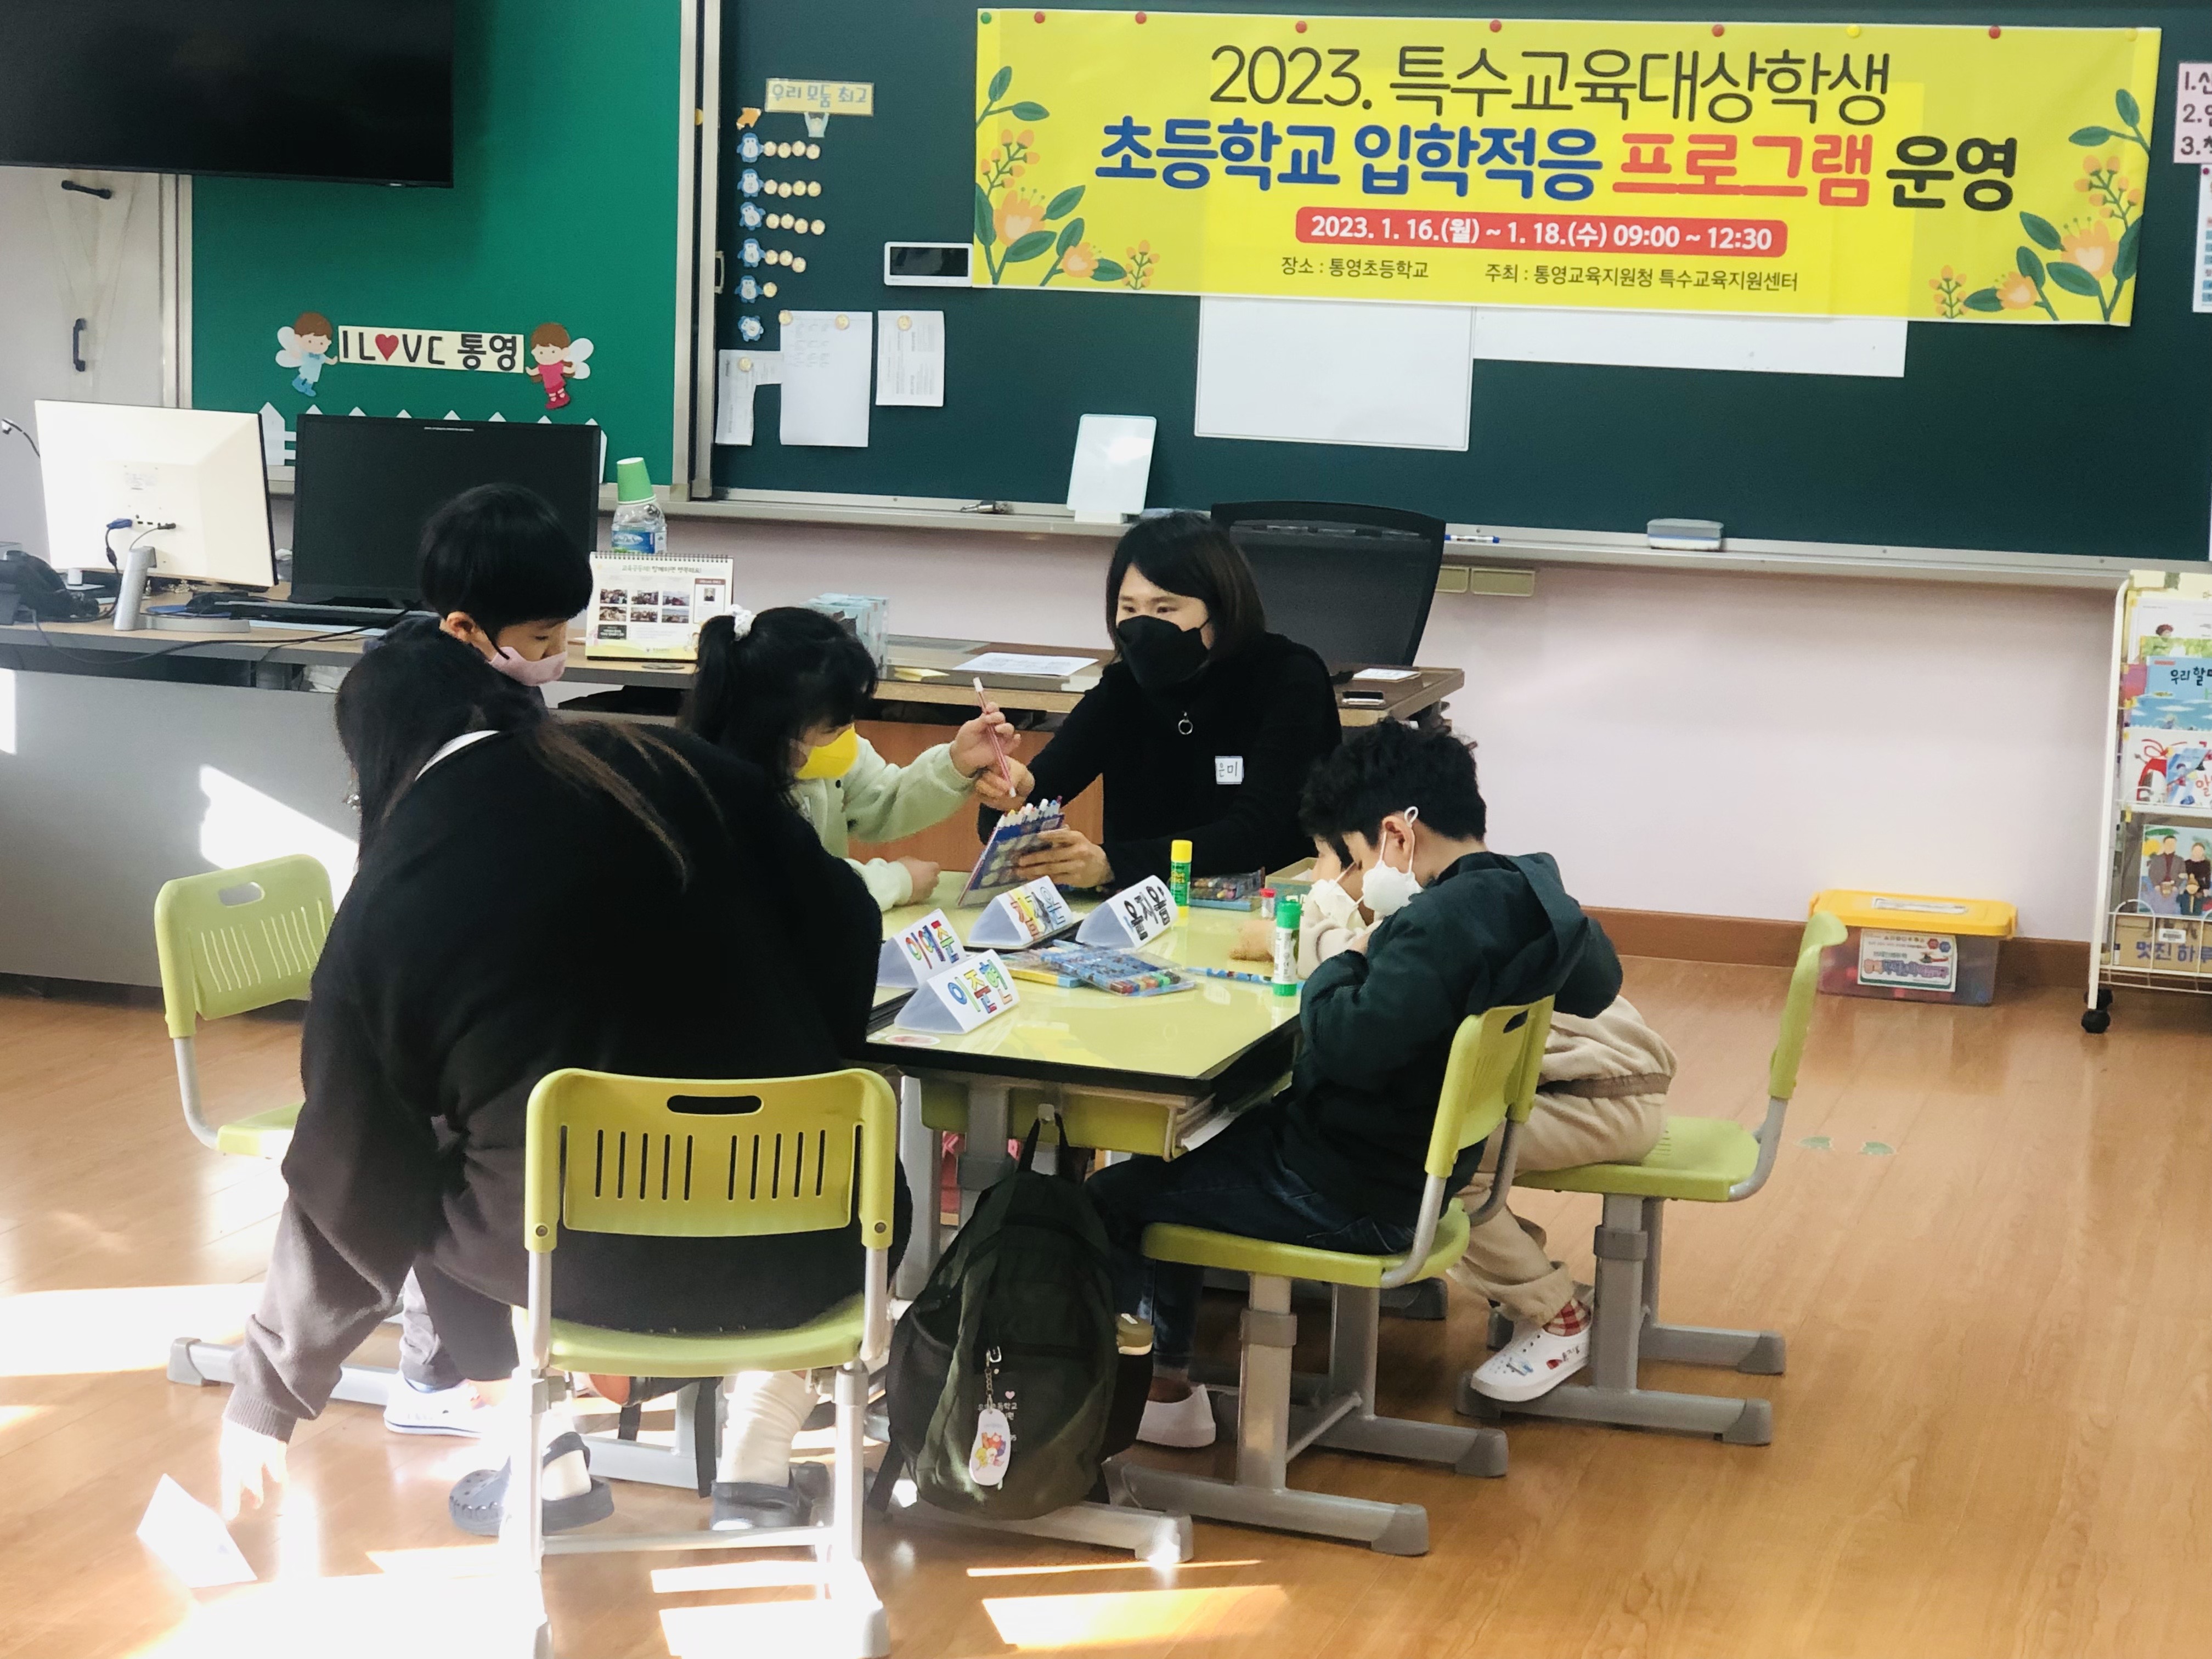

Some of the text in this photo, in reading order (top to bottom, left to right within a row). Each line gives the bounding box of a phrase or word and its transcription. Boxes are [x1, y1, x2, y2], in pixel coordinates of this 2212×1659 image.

[772, 84, 867, 108] 우리 모둠 최고
[1210, 45, 1889, 126] 2023. 특수교육대상학생
[1096, 116, 2018, 211] 초등학교 입학적응 프로그램 운영
[1311, 215, 1374, 239] 2023.
[1383, 218, 1400, 240] 1.
[1508, 221, 1526, 244] 1.
[1613, 224, 1680, 247] 09:00
[1708, 227, 1773, 250] 12:30
[1281, 256, 1314, 275] 장소
[1329, 257, 1429, 280] 통영초등학교
[1485, 263, 1519, 284] 주최
[1533, 264, 1653, 288] 통영교육지원청
[1658, 269, 1798, 292] 특수교육지원센터
[458, 334, 516, 371] 통영
[2170, 669, 2190, 685] 우리
[905, 920, 960, 969] 이예준
[2136, 941, 2171, 960] 멋진
[947, 959, 1013, 1013] 이준현
